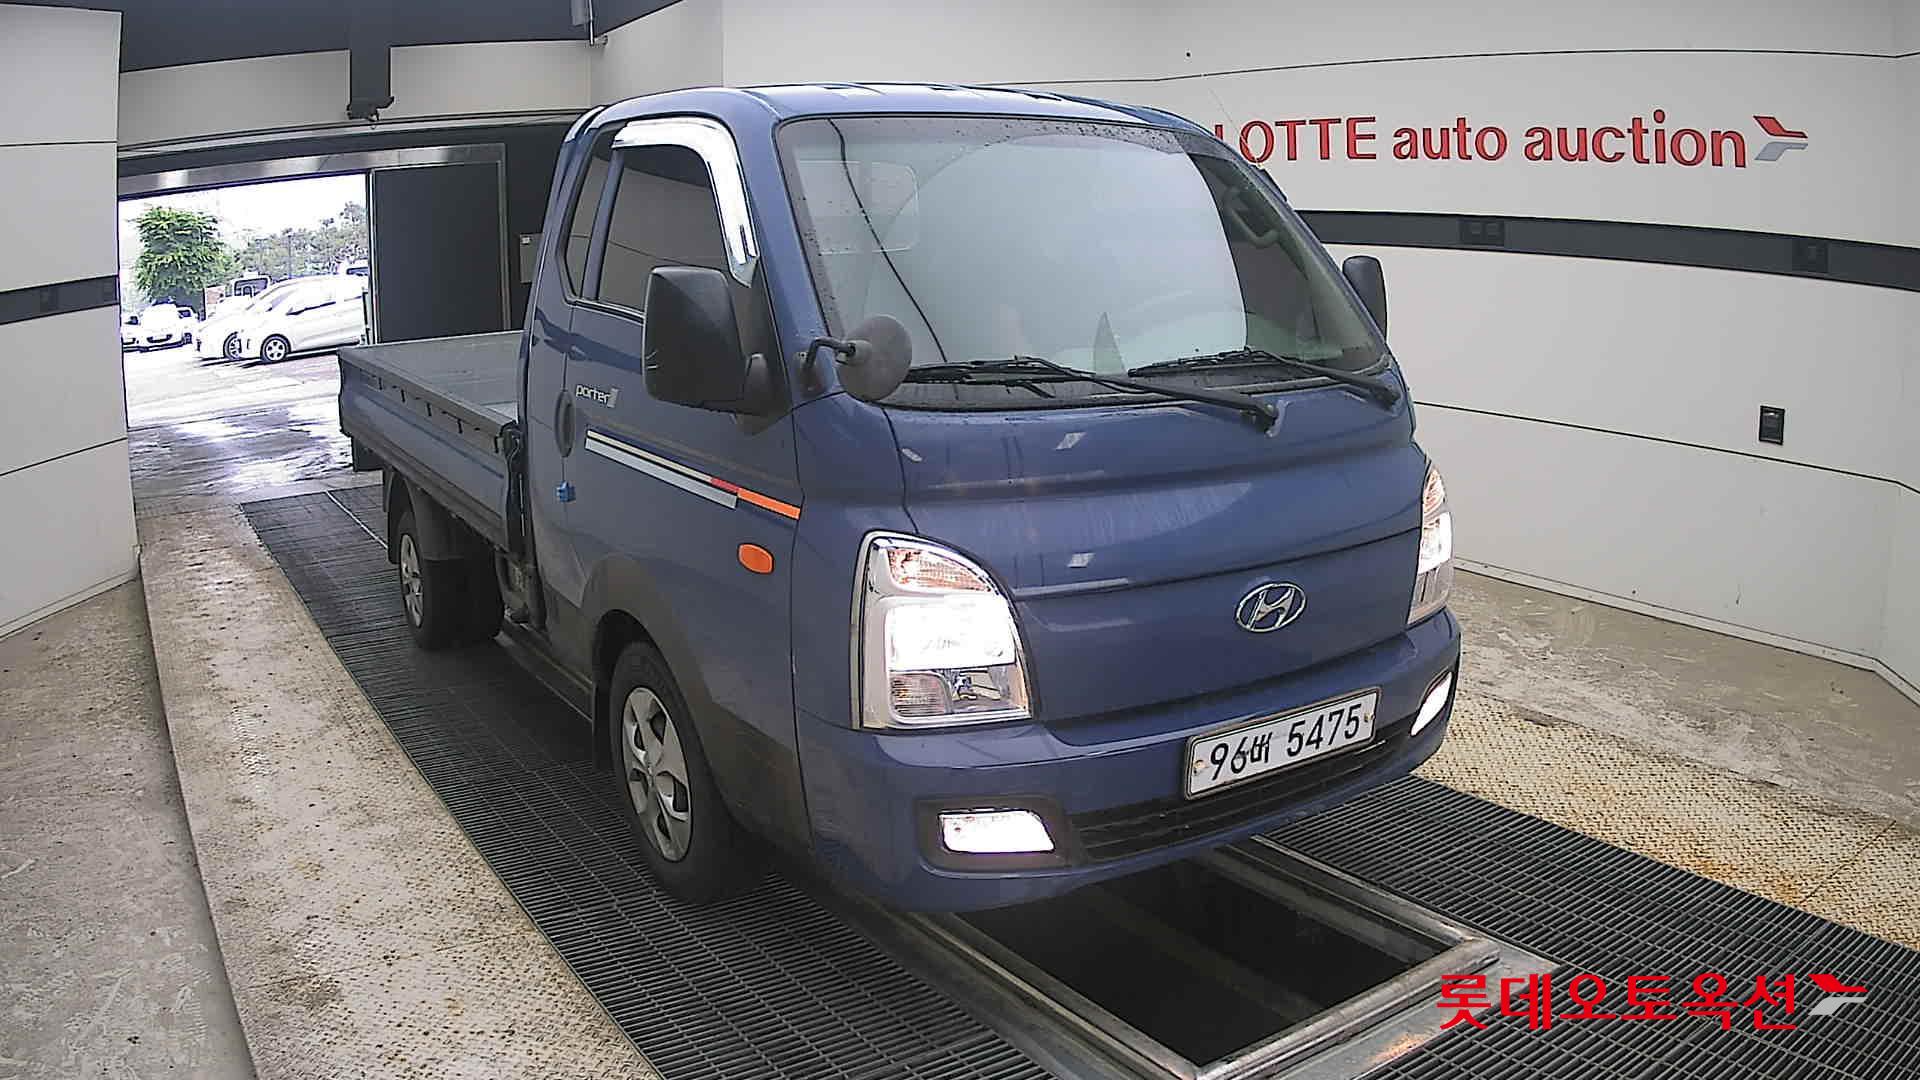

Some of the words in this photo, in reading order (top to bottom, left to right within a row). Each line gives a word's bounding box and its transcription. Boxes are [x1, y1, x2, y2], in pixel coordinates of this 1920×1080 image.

[1391, 116, 1509, 162] auto
[1522, 108, 1747, 168] auction
[1287, 704, 1361, 756] 5475
